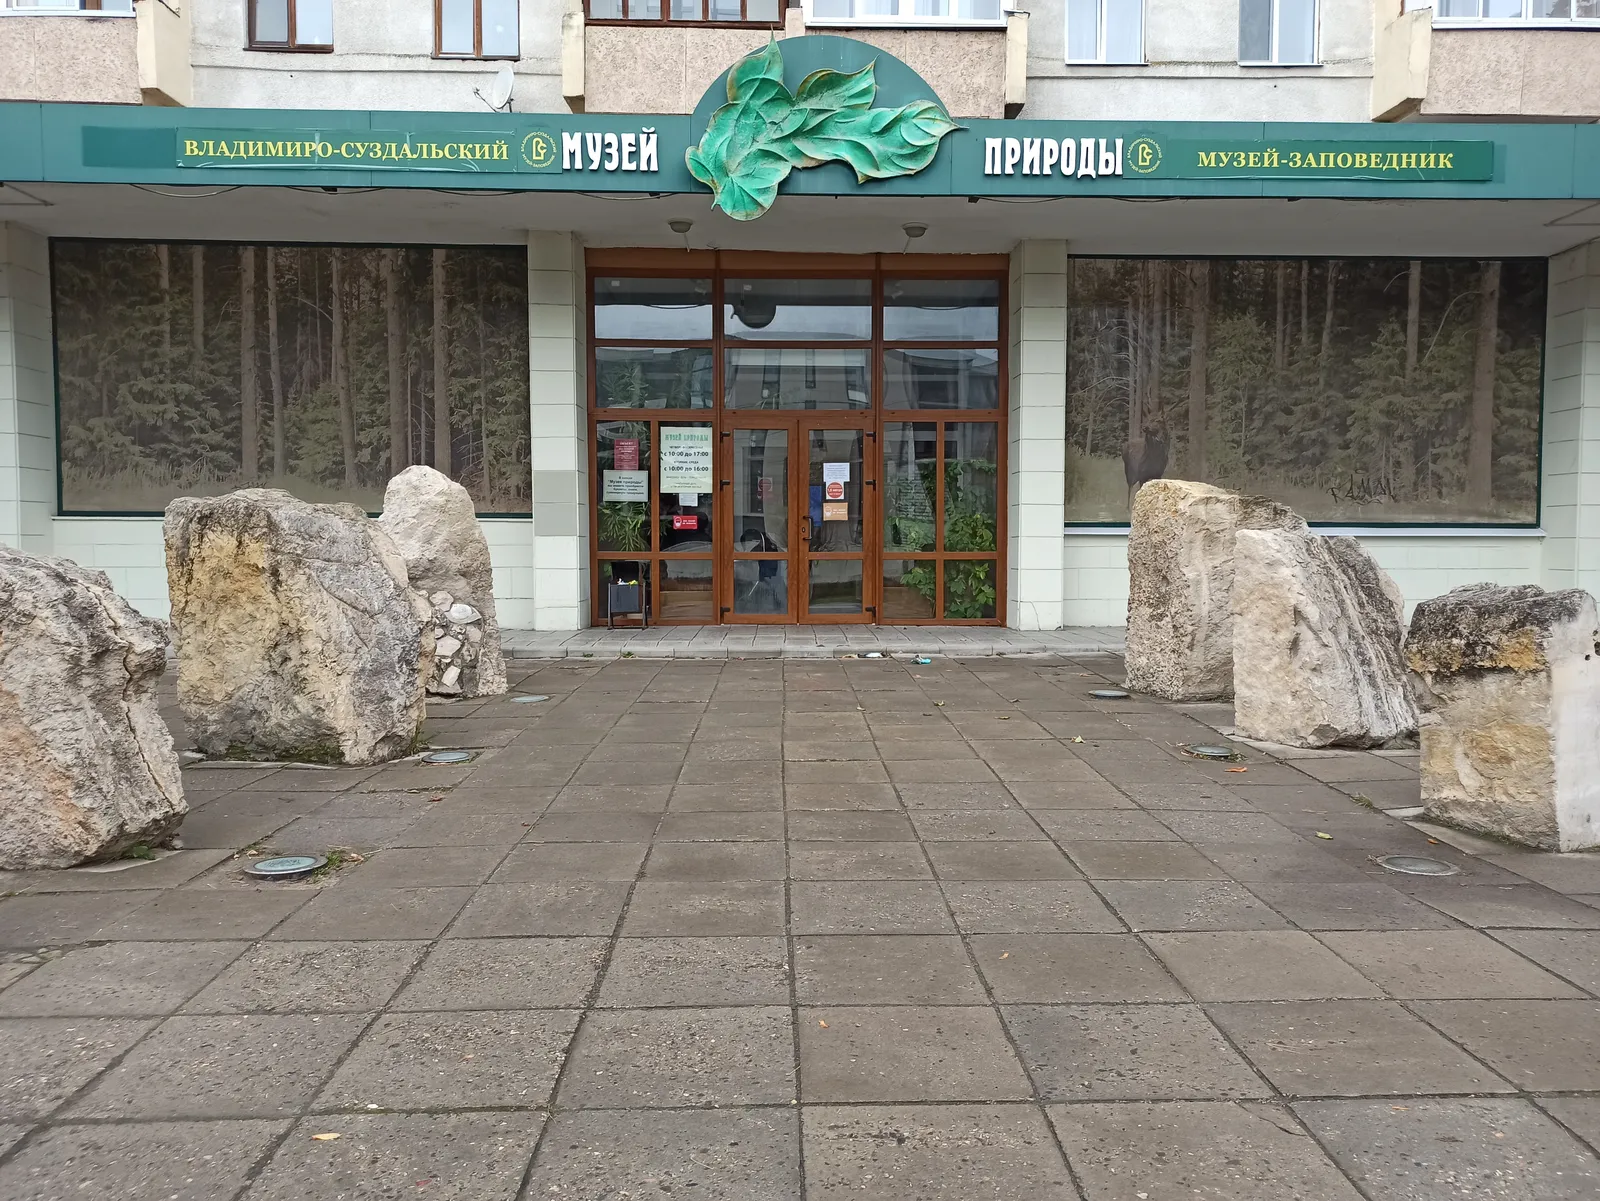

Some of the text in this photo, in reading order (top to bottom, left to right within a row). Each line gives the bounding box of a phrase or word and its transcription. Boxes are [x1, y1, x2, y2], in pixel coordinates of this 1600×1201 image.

[184, 139, 509, 161] ВЛАДИМИРО-СУЗДАЛЬСКИЙ
[561, 126, 1124, 179] МУЗЕЙ ПРИРОДЫ
[1196, 148, 1454, 171] МУЗЕЙ-ЗАПОВЕДНИК
